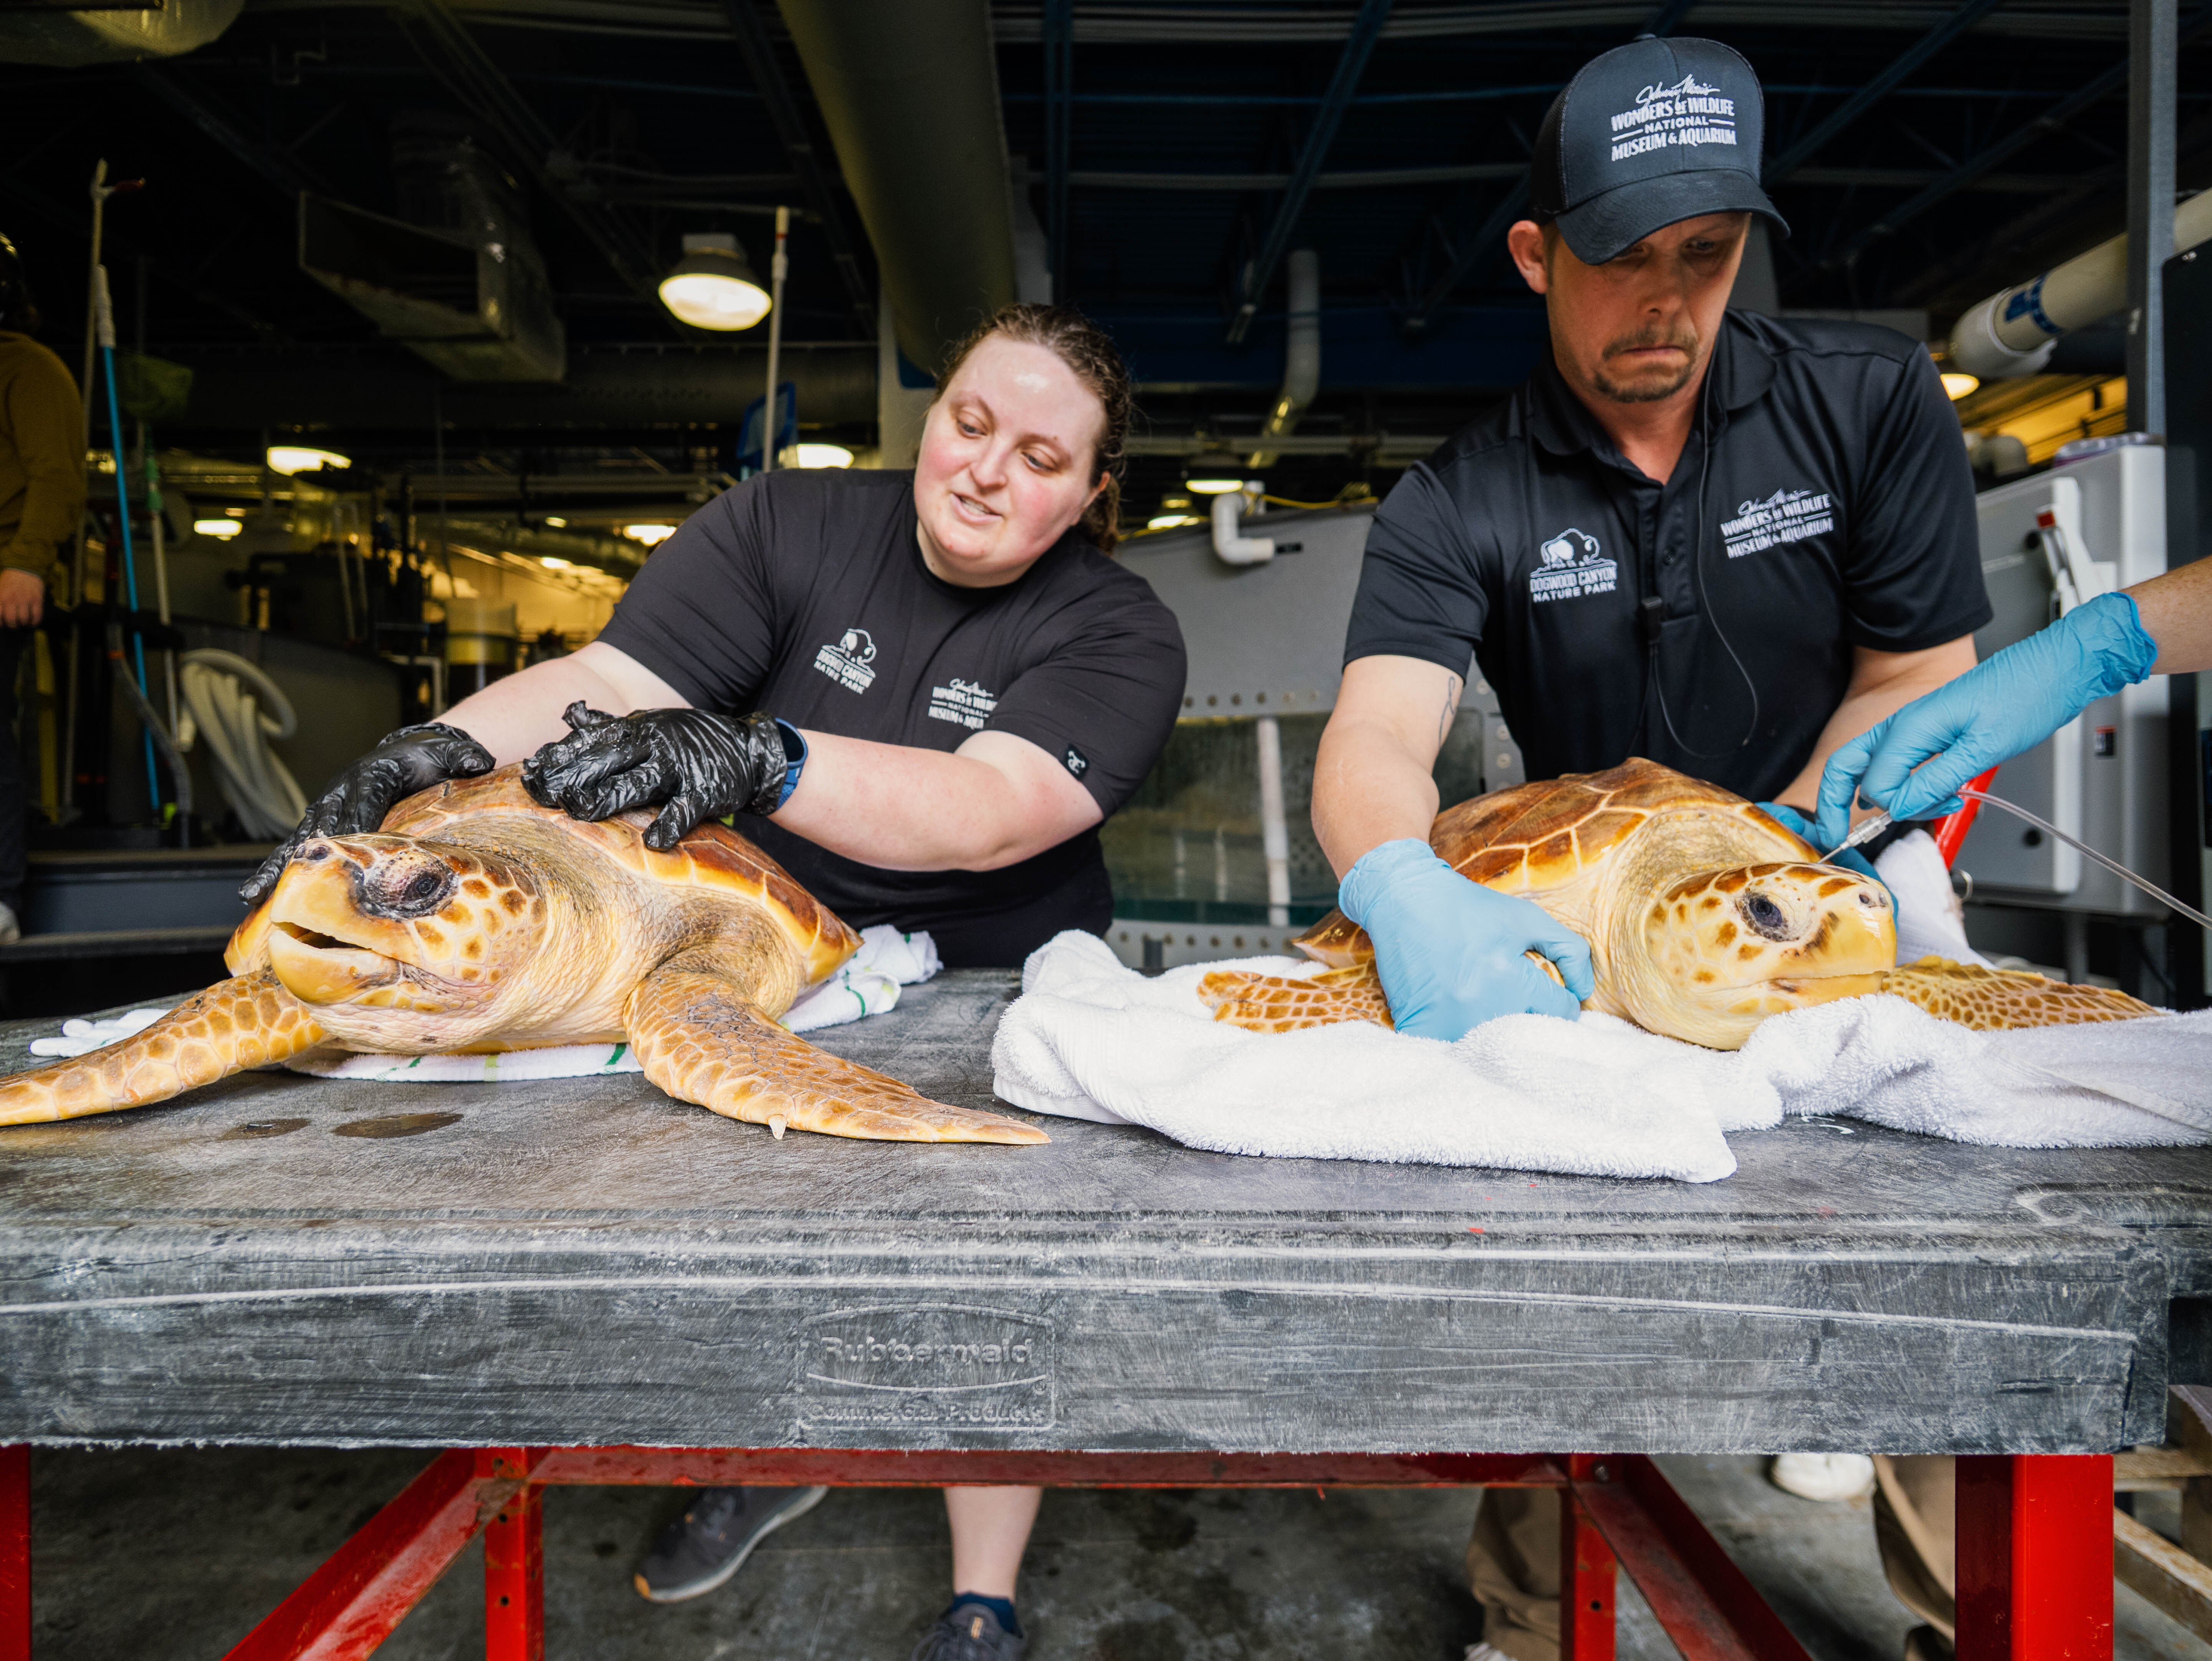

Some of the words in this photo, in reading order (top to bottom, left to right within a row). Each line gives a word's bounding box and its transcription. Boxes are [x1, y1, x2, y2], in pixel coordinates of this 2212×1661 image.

[1611, 100, 1674, 132] WONDERS
[1687, 97, 1735, 116] WILDLIFE
[1644, 115, 1709, 134] NATIONAL
[1611, 132, 1667, 162] MUSEUM
[1668, 132, 1678, 145] &
[1678, 127, 1737, 147] AQUARIUM
[1720, 509, 1773, 537] WONDERS
[1782, 493, 1831, 518] WILDLIFE
[1751, 515, 1805, 537] NATIONAL
[1726, 534, 1775, 560] MUSEUM
[1772, 533, 1781, 543] &
[1780, 517, 1834, 543] AQUARIUM
[1530, 573, 1577, 593] DOGWOOD
[1578, 566, 1617, 586] CANYON
[1533, 586, 1582, 603] NATURE
[1584, 580, 1616, 595] PARK
[840, 676, 865, 695] PARK
[821, 1336, 1033, 1364] Rubbermaid
